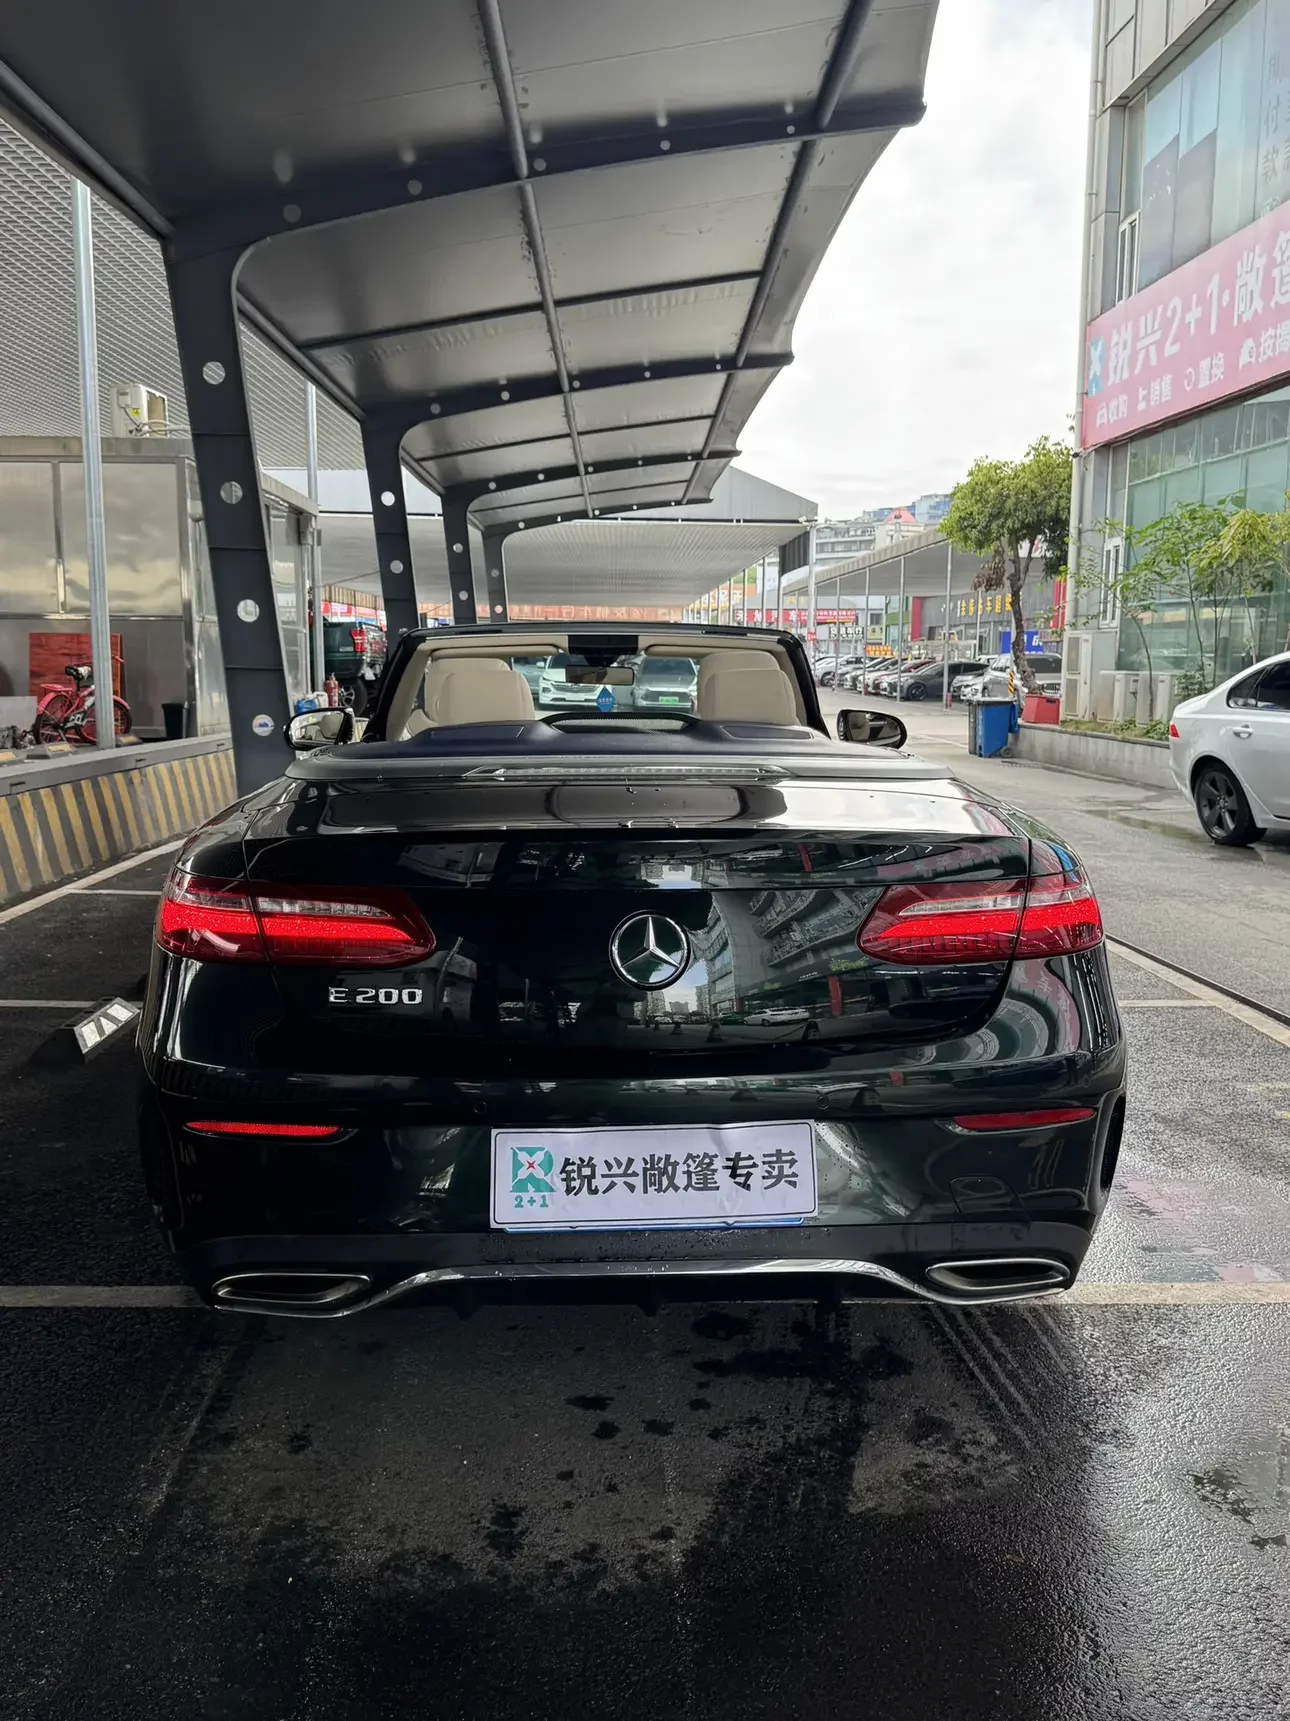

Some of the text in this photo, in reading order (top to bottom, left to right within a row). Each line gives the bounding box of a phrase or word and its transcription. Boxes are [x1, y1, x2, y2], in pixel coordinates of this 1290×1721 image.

[1198, 352, 1225, 389] 置换
[329, 987, 422, 1004] E 200
[559, 1148, 799, 1197] 锐兴敞篷专卖
[514, 1195, 549, 1208] 2+1
